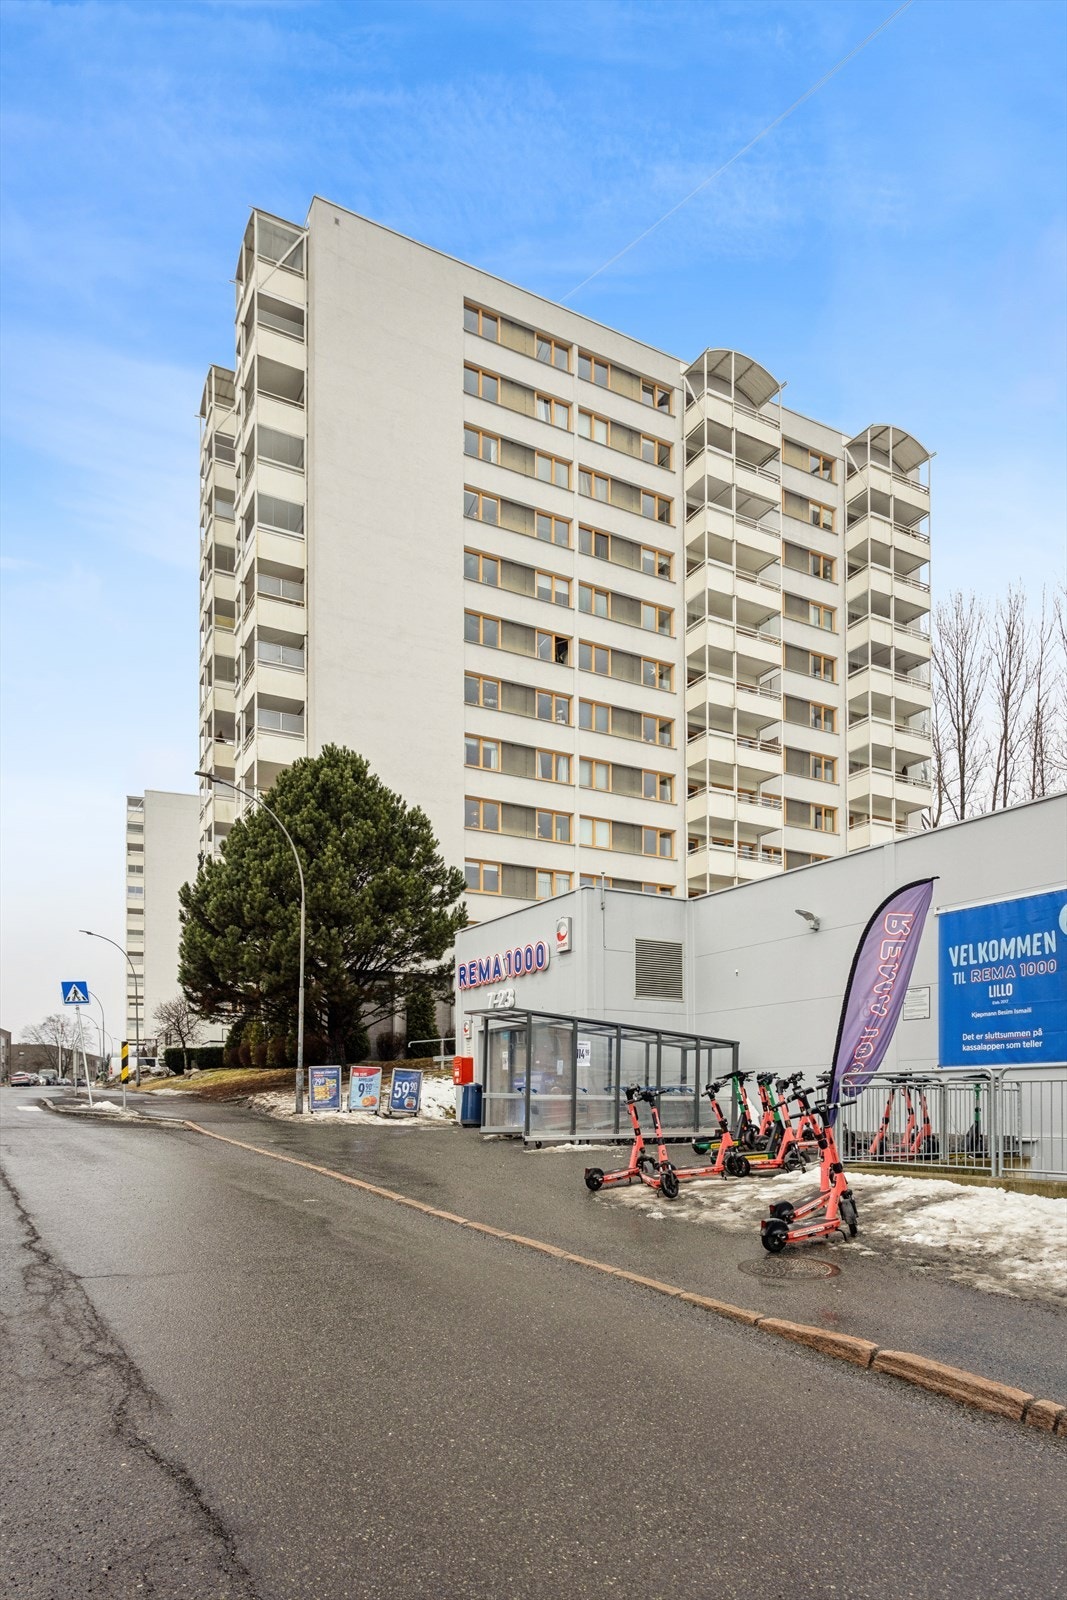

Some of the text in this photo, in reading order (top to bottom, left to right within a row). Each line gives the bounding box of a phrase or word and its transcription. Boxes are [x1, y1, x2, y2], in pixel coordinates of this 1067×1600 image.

[948, 930, 1057, 968] VELKOMMEN
[458, 940, 548, 990] REMA 1000
[952, 958, 1058, 985] TIL REMA 1000
[988, 982, 1013, 998] LILLO
[971, 1011, 998, 1019] Kjøpmann
[962, 1033, 975, 1041] Det
[984, 1030, 1031, 1040] sluttsummen
[1032, 1028, 1043, 1037] på
[962, 1042, 1005, 1052] kassalappen
[1022, 1040, 1043, 1048] teller
